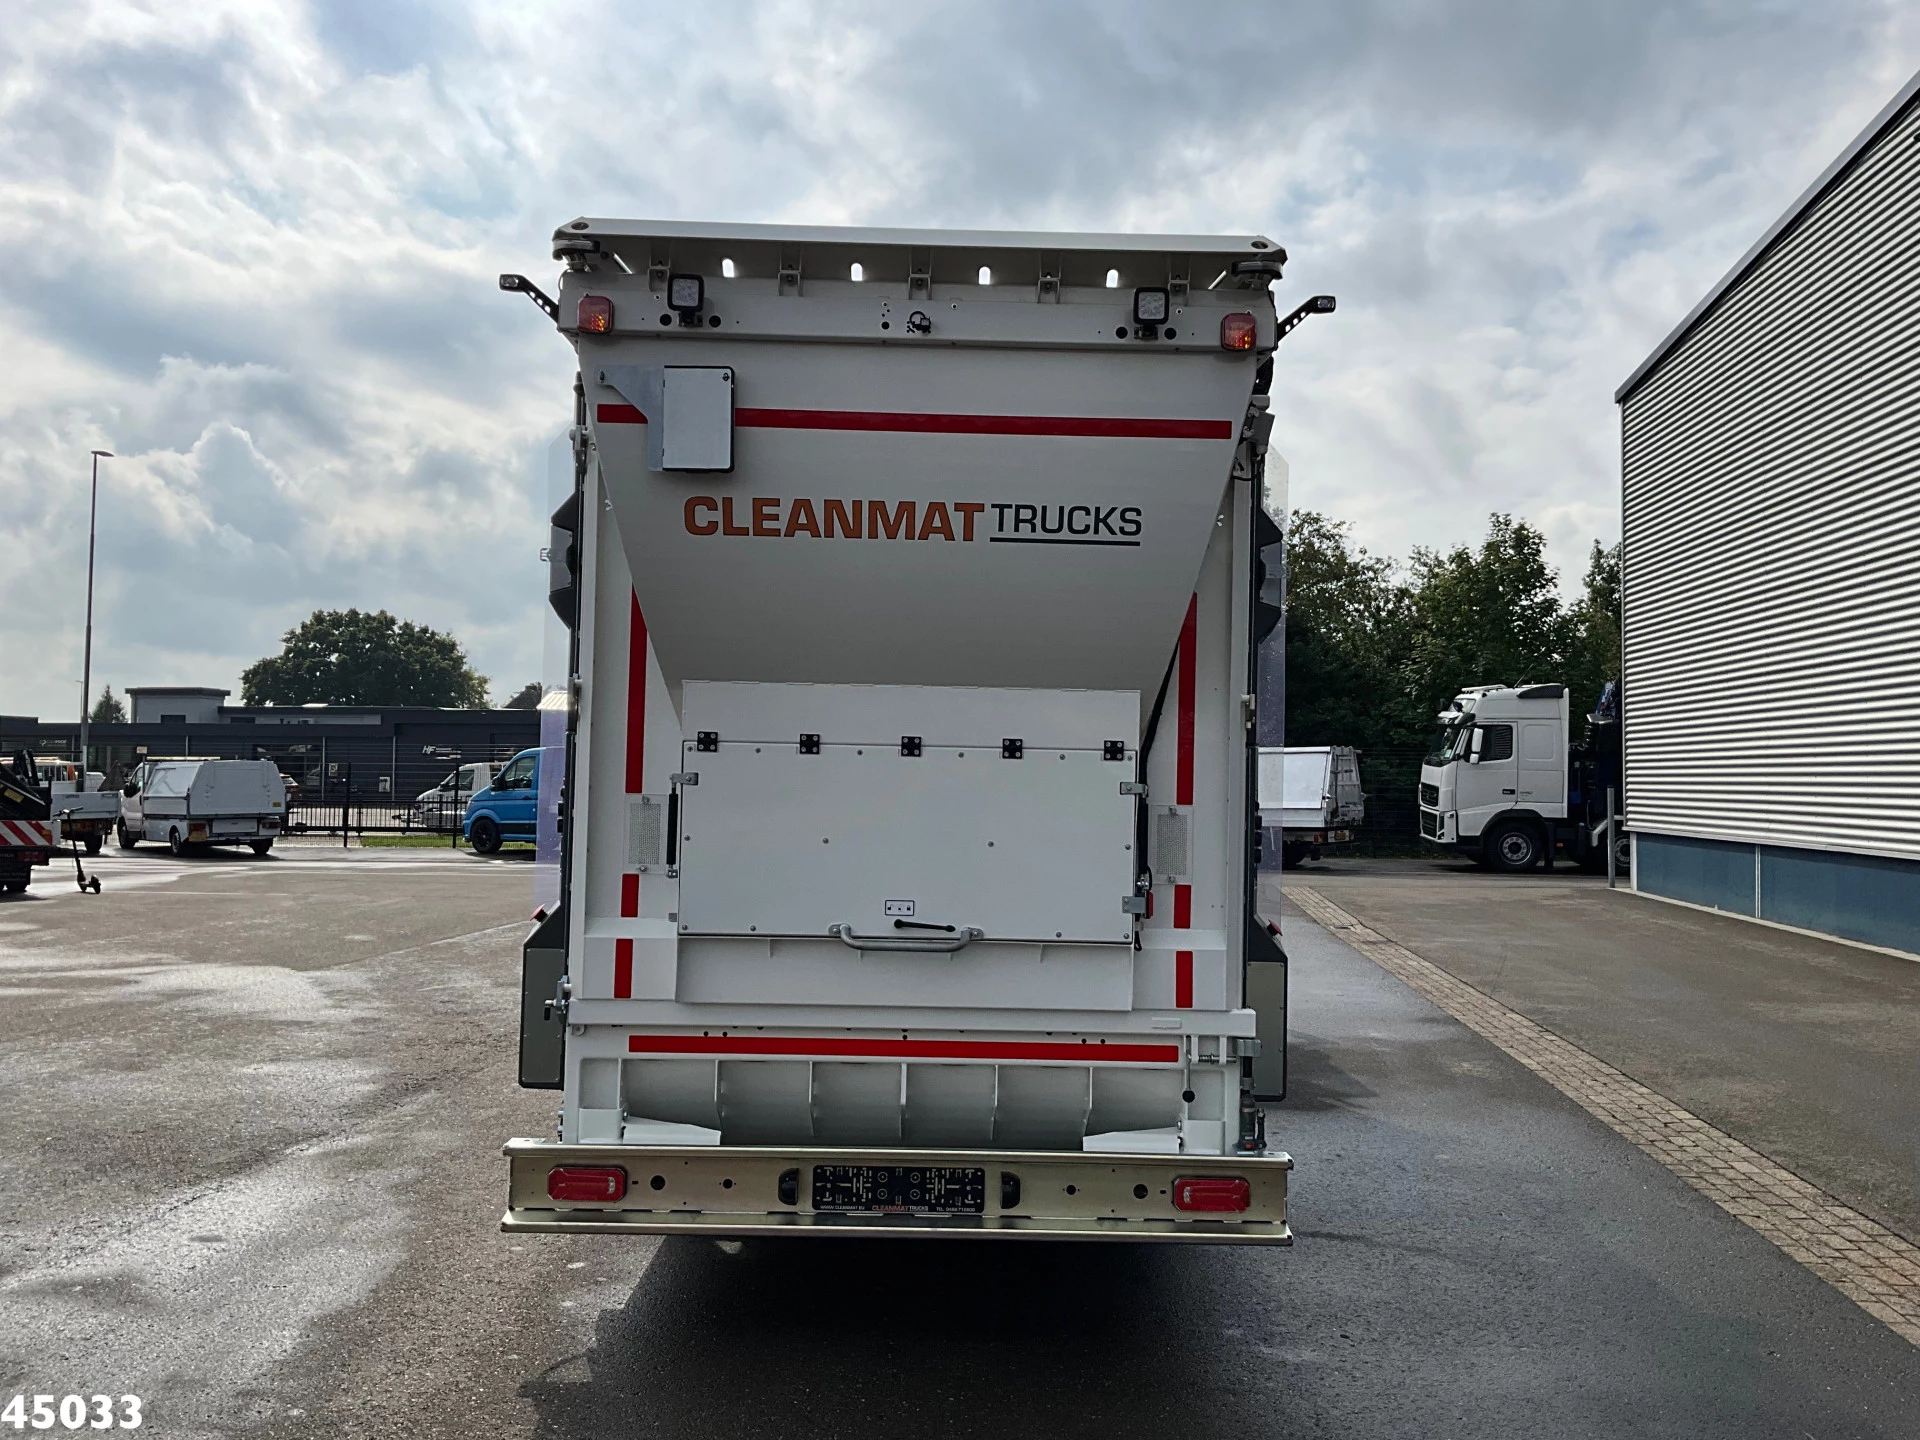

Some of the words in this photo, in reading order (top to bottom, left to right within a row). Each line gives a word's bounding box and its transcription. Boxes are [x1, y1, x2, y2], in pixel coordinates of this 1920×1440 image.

[683, 495, 985, 542] CLEANMAT
[991, 503, 1143, 537] TRUCKS
[871, 1204, 909, 1212] CLEANMAT
